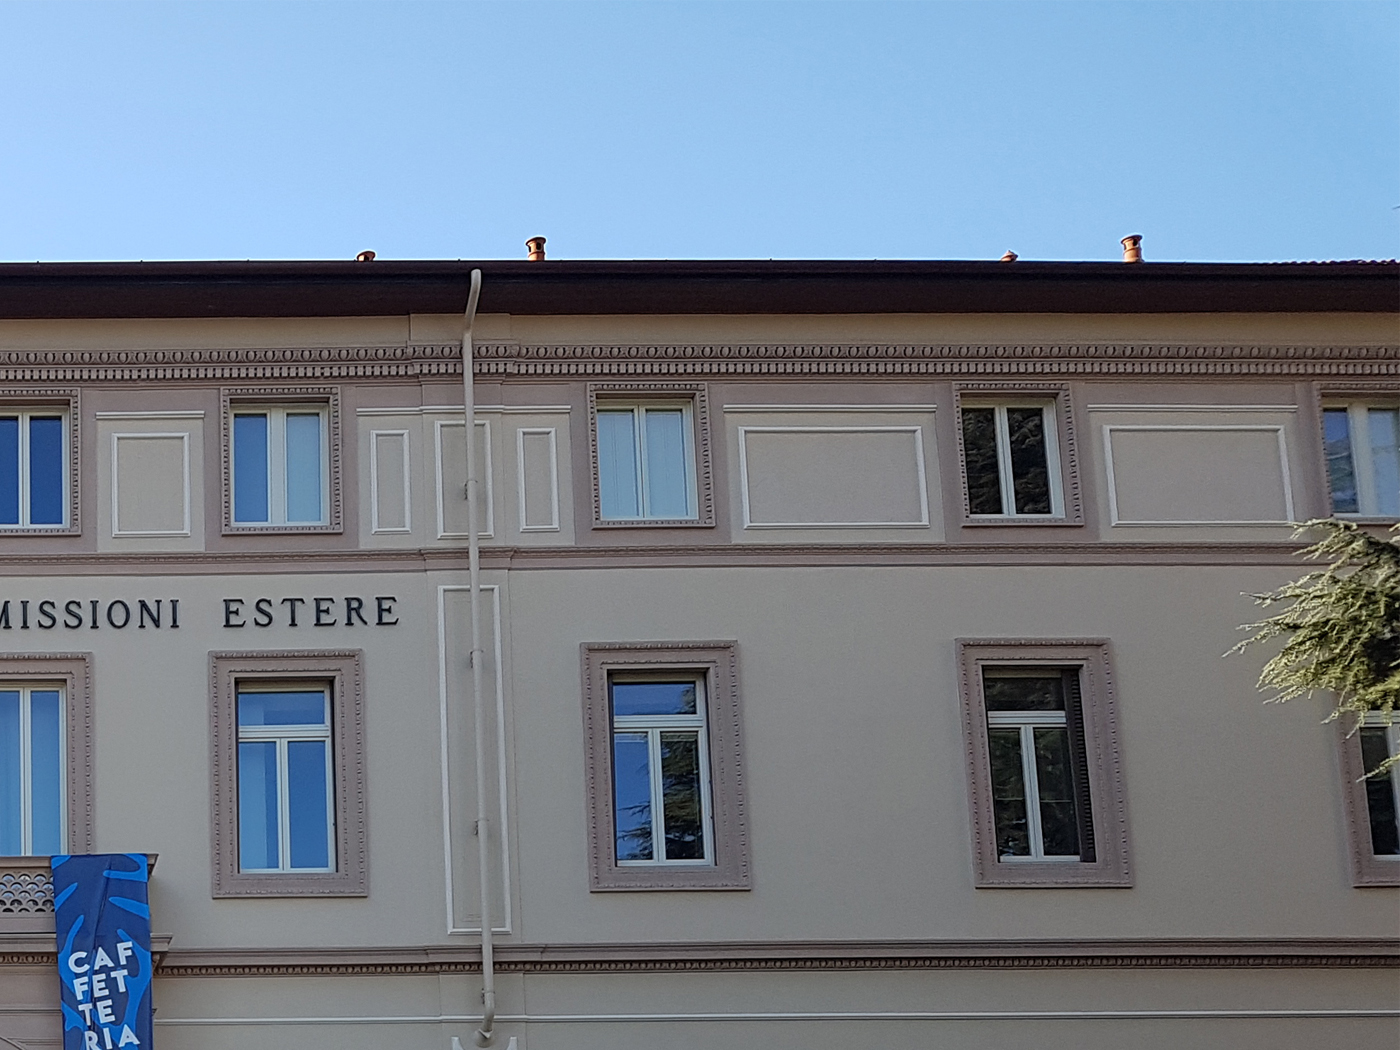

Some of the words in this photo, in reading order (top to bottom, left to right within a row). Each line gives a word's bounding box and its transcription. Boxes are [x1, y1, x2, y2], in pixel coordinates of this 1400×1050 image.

[223, 596, 400, 628] ESTERE
[68, 941, 133, 974] CAF
[73, 969, 129, 1001] FET
[78, 999, 116, 1026] TE
